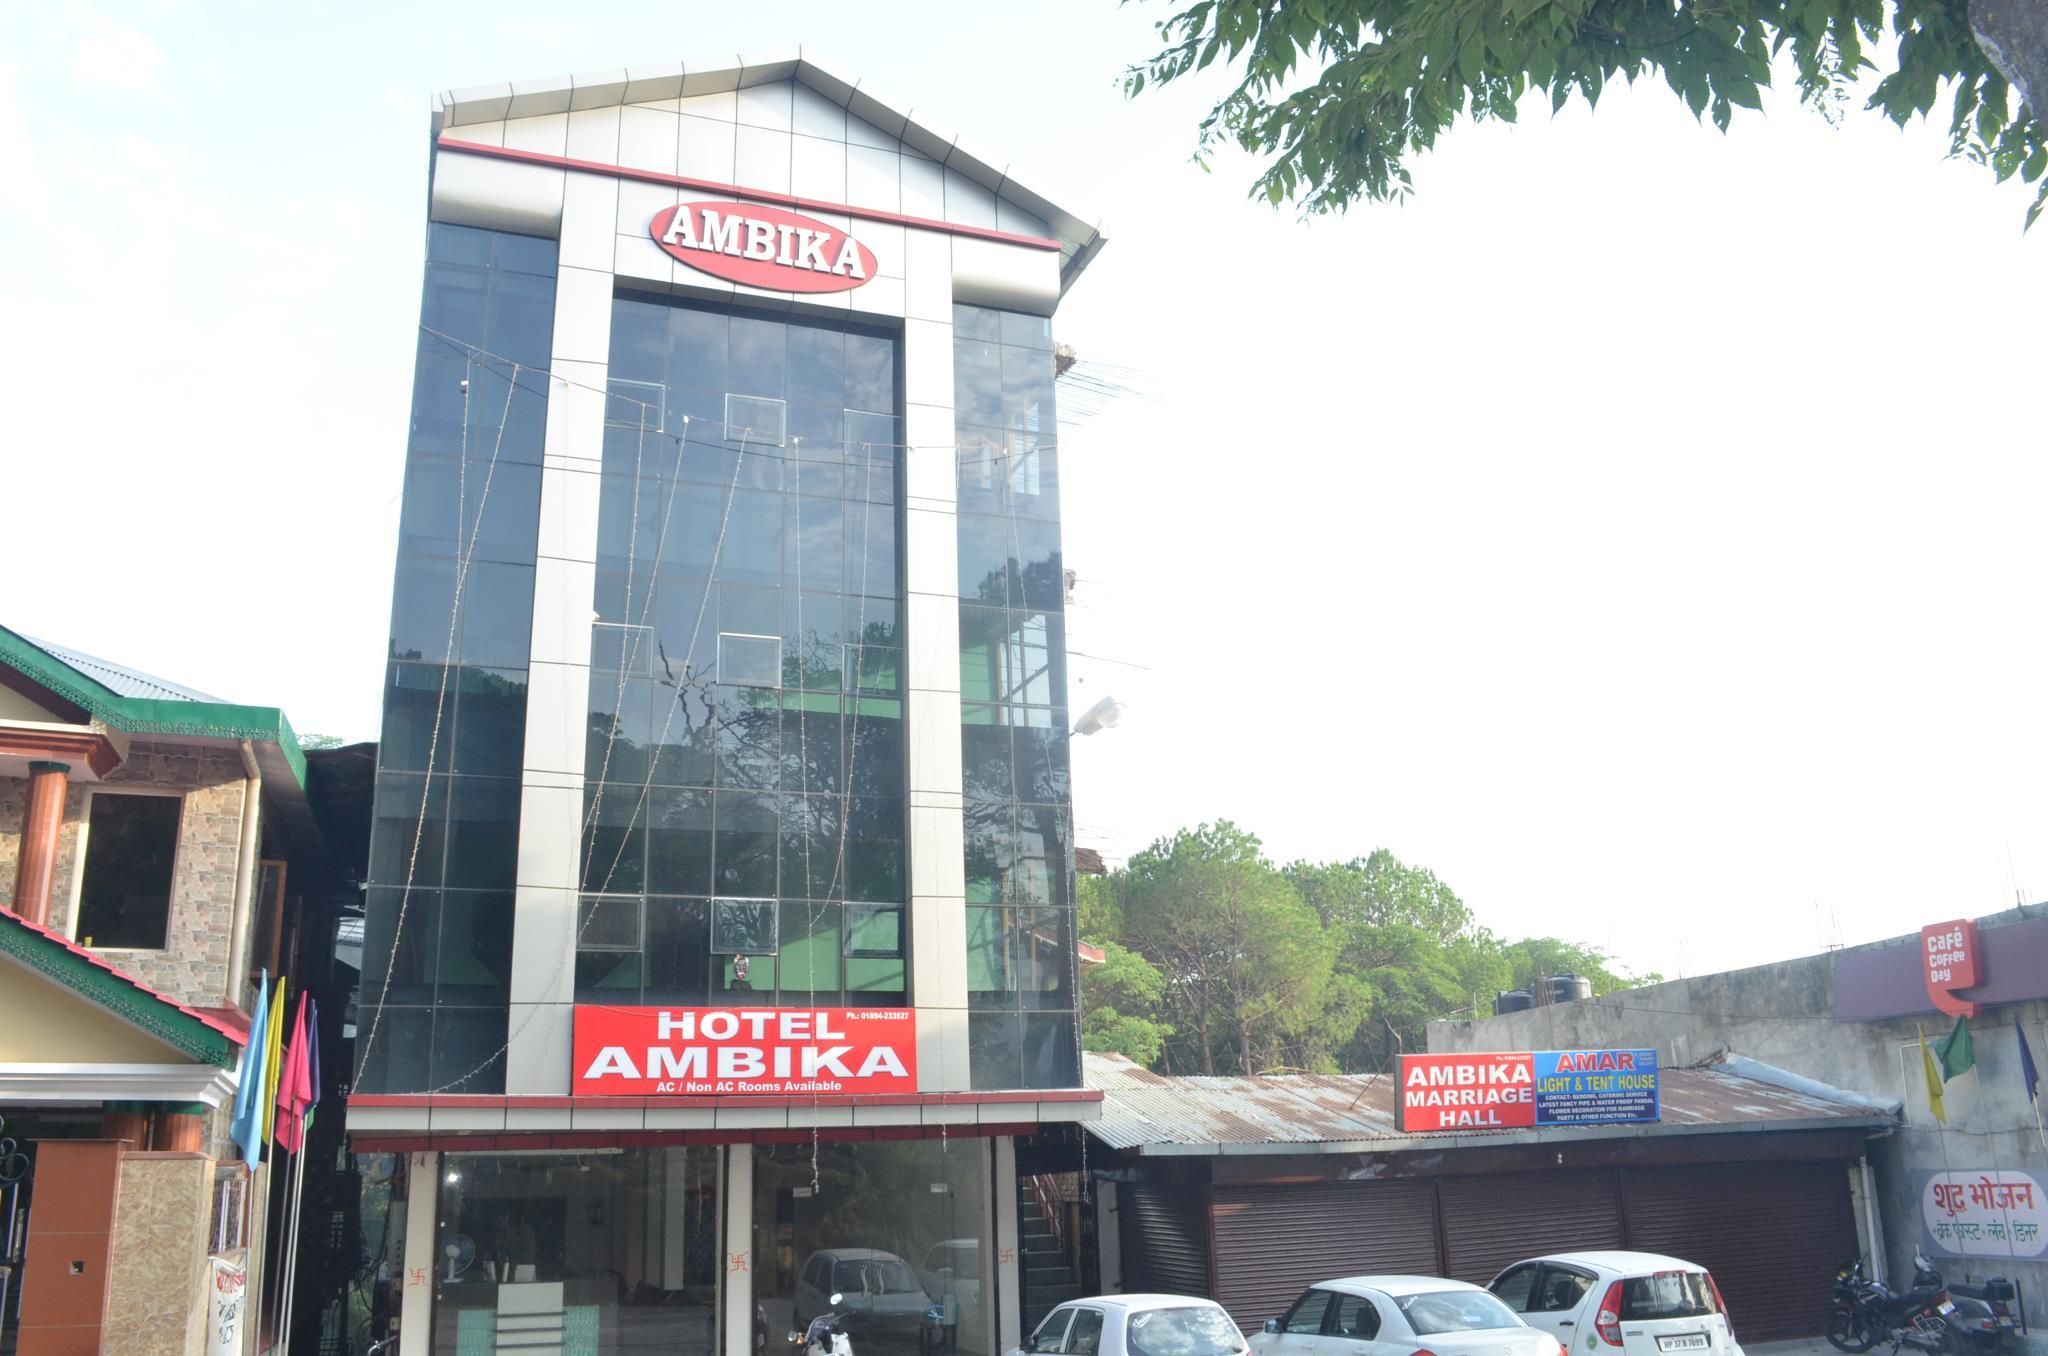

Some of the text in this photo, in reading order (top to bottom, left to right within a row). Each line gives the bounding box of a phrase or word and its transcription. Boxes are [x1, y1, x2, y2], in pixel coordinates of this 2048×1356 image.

[663, 205, 865, 279] AMBIKA
[1929, 951, 1965, 967] Coffee
[1931, 968, 1951, 983] Day
[657, 1011, 846, 1041] HOTEL
[583, 1046, 909, 1079] AMBIKA
[1555, 1052, 1636, 1073] AMAR
[1407, 1063, 1532, 1087] AMBIKA
[1537, 1073, 1655, 1093] LIGHT & TENT HOUSE
[656, 1082, 674, 1093] AC
[687, 1082, 712, 1092] Non
[716, 1082, 734, 1092] AC
[738, 1082, 781, 1092] Rooms
[784, 1081, 842, 1092] Available
[1405, 1087, 1533, 1107] MARRIAGE
[1439, 1109, 1502, 1127] HALL
[1968, 1176, 2034, 1210] भोजन
[2012, 1220, 2038, 1241] डिनर
[1664, 1340, 1673, 1348] HP
